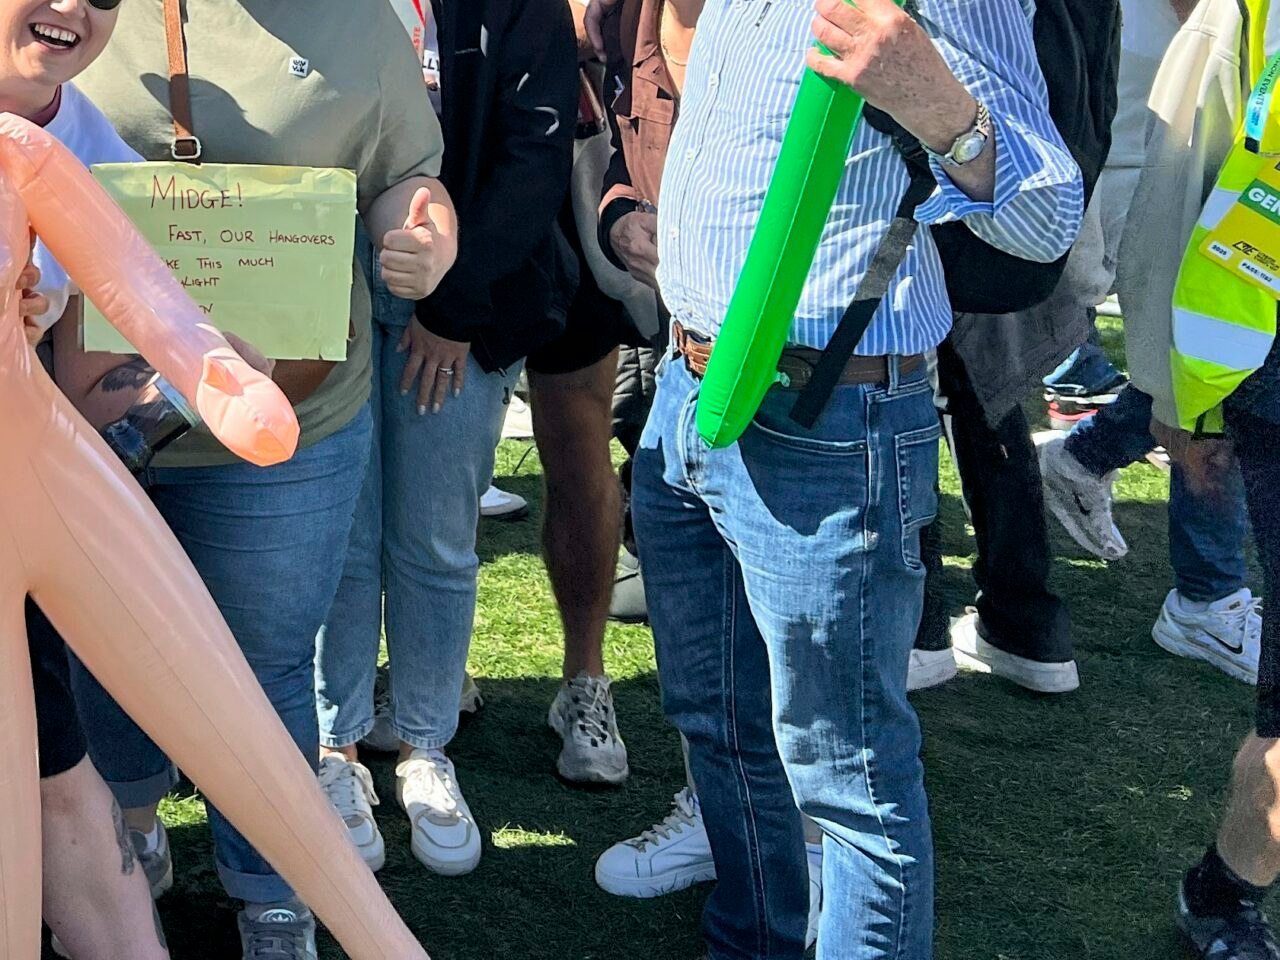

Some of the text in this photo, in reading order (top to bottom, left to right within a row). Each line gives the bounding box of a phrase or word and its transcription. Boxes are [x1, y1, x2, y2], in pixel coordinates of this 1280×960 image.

[151, 175, 244, 211] MIDGE!
[169, 224, 336, 246] FAST, OUR HANGOVERS
[166, 256, 274, 270] KE THIS MUCH
